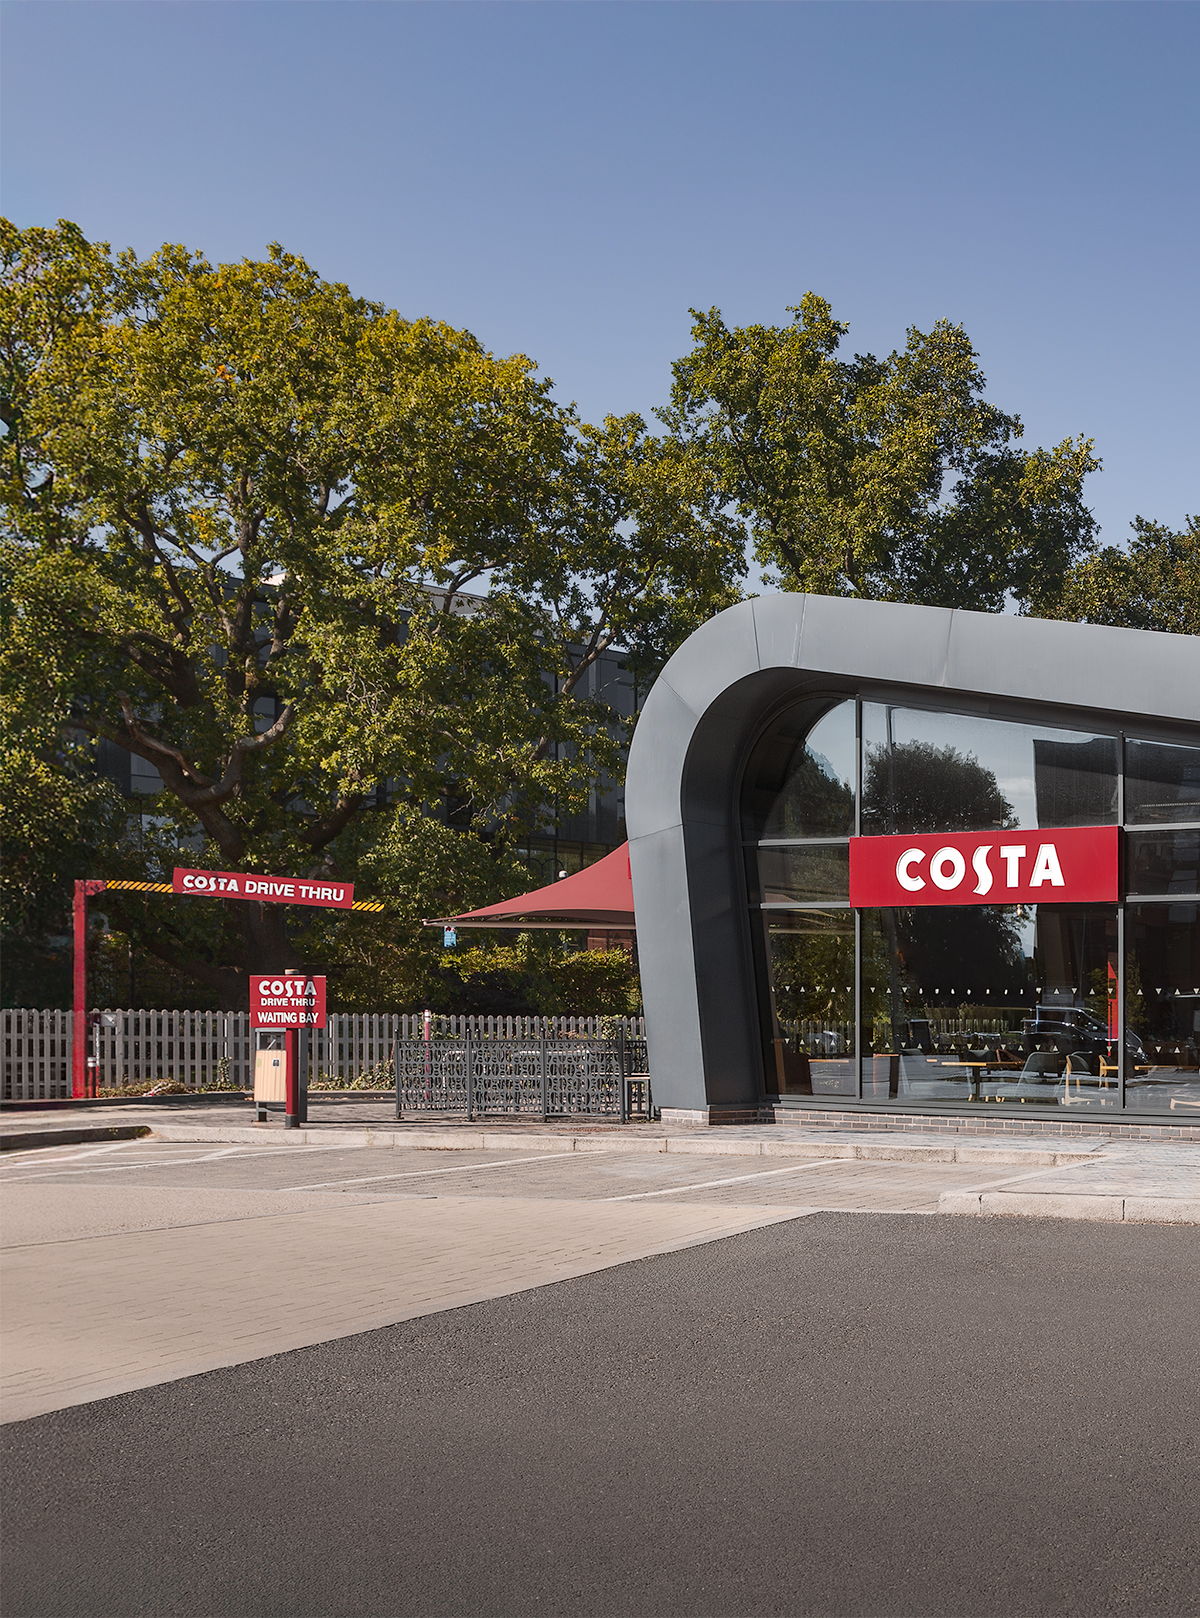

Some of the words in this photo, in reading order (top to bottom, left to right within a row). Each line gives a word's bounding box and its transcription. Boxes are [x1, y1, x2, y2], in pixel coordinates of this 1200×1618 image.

[895, 843, 1065, 896] COSTA
[182, 874, 239, 892] COSTA
[245, 880, 295, 897] DRIVE
[299, 886, 344, 902] THRU
[258, 980, 317, 998] COSTA
[260, 997, 289, 1007] DRIVE
[290, 997, 316, 1007] THRU
[257, 1012, 298, 1024] WAITING
[299, 1012, 319, 1024] BAY
